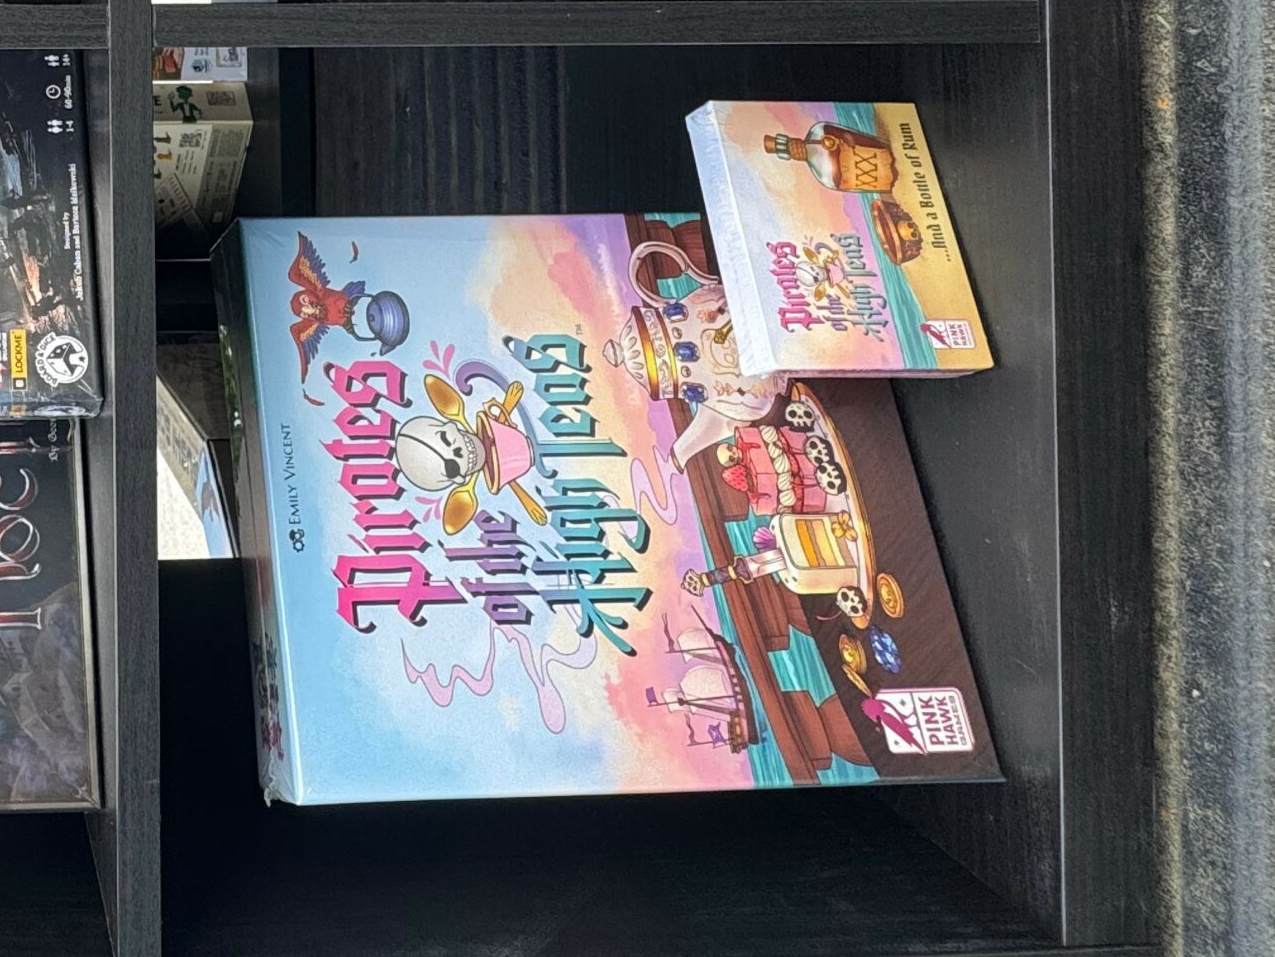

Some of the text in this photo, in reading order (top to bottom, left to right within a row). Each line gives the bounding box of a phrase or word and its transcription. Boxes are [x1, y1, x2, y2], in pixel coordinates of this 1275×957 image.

[65, 120, 74, 132] 1-4
[899, 122, 918, 150] Rum
[852, 146, 877, 188] XXX
[905, 154, 923, 168] of
[912, 172, 935, 208] Bottle
[62, 212, 71, 250] Designed by
[926, 212, 939, 220] a
[73, 236, 81, 249] and
[75, 276, 84, 300] Jakub
[766, 242, 825, 333] Pirates
[833, 233, 889, 342] High Teas
[813, 293, 853, 332] of the
[14, 334, 23, 373] LOCKME
[38, 332, 55, 350] DICE
[947, 324, 961, 346] PINK
[35, 358, 57, 385] BOARD
[497, 334, 627, 478] Teas
[47, 418, 58, 442] Geo
[279, 422, 302, 525] EMILY VINCENT
[319, 360, 468, 634] Pirates
[437, 509, 540, 626] of the
[527, 478, 653, 655] High
[917, 695, 945, 746] PINK
[934, 696, 959, 745] HAWK
